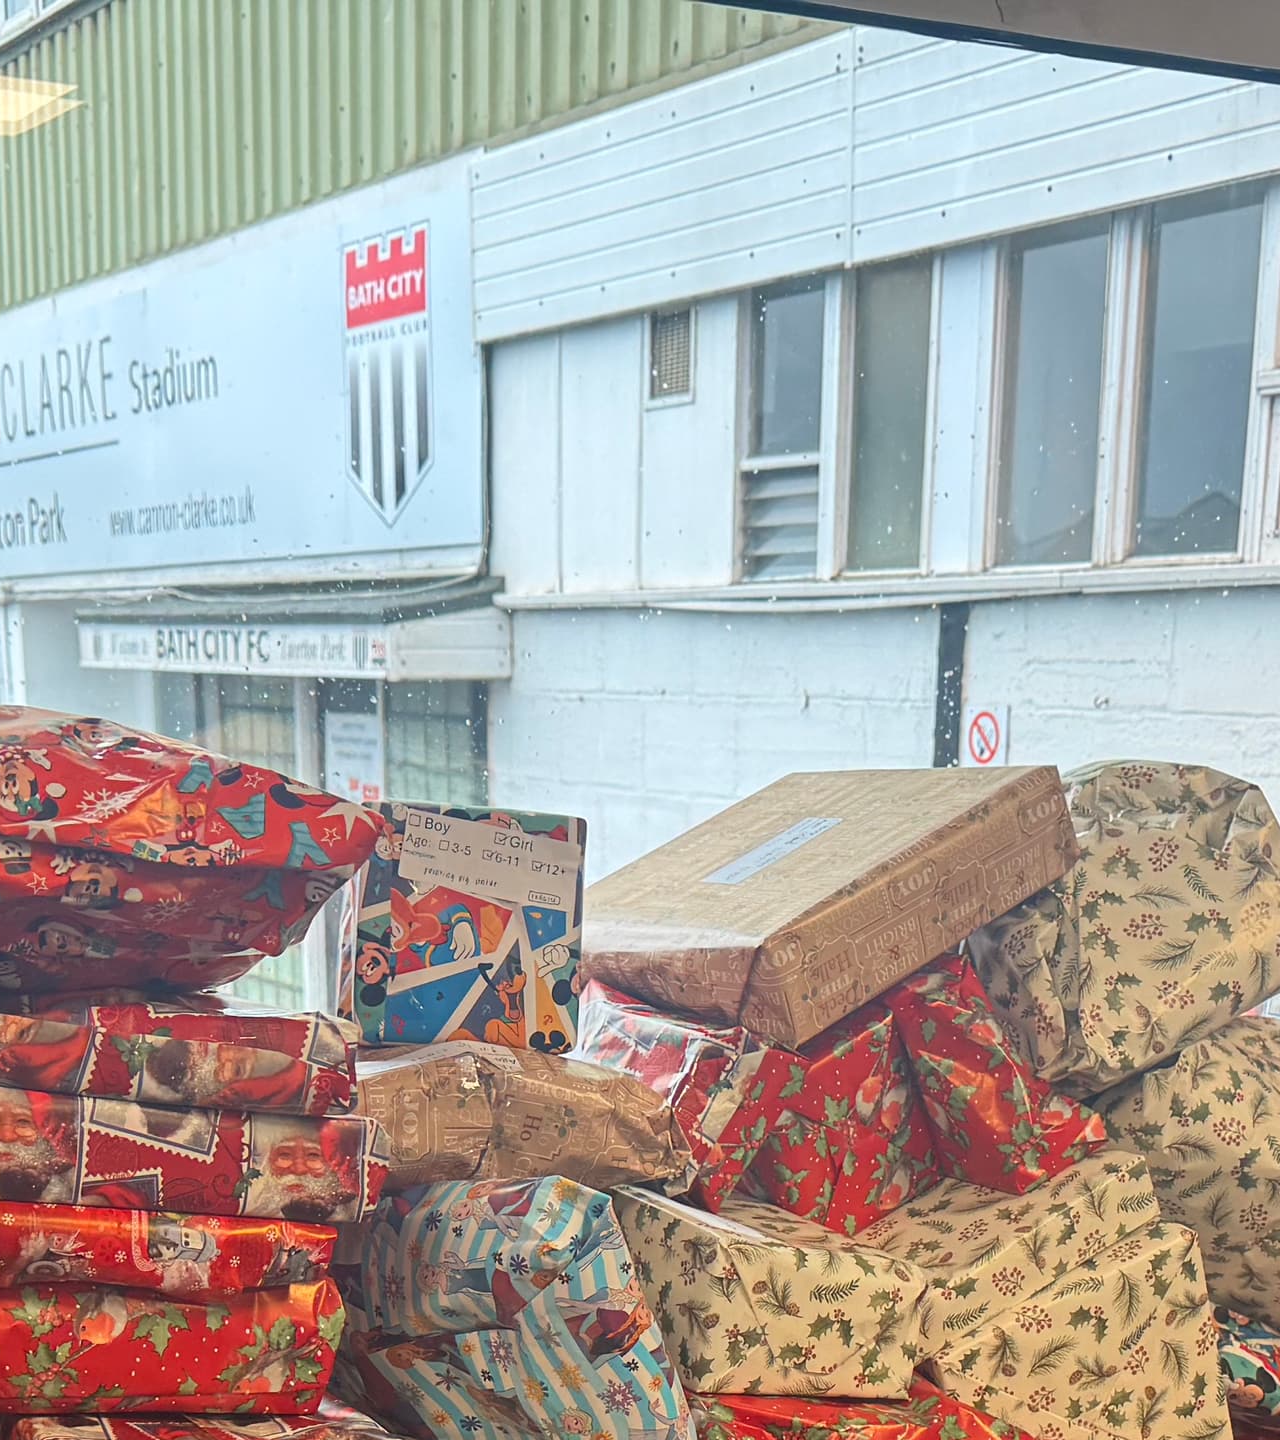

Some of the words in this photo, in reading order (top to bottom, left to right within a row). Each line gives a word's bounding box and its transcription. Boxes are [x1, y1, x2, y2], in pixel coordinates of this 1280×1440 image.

[348, 278, 385, 310] BATH
[387, 267, 424, 300] CITY
[128, 347, 219, 415] Stadium
[29, 492, 67, 543] Park
[109, 485, 256, 536] www.cannon-clarke.co.uk
[156, 629, 197, 660] BATH
[204, 629, 241, 662] CITY
[247, 630, 270, 663] FC
[1026, 795, 1060, 825] JOY
[424, 817, 451, 834] Boy
[509, 835, 533, 852] Girl
[452, 842, 471, 856] 3-5
[495, 852, 520, 866] 6-11
[544, 864, 566, 876] 12+
[894, 865, 935, 897] JOY
[864, 914, 922, 961] BRIGHT
[810, 950, 853, 982] Halls
[873, 952, 920, 985] MERRY
[817, 984, 864, 1018] Deck
[821, 974, 855, 999] THE
